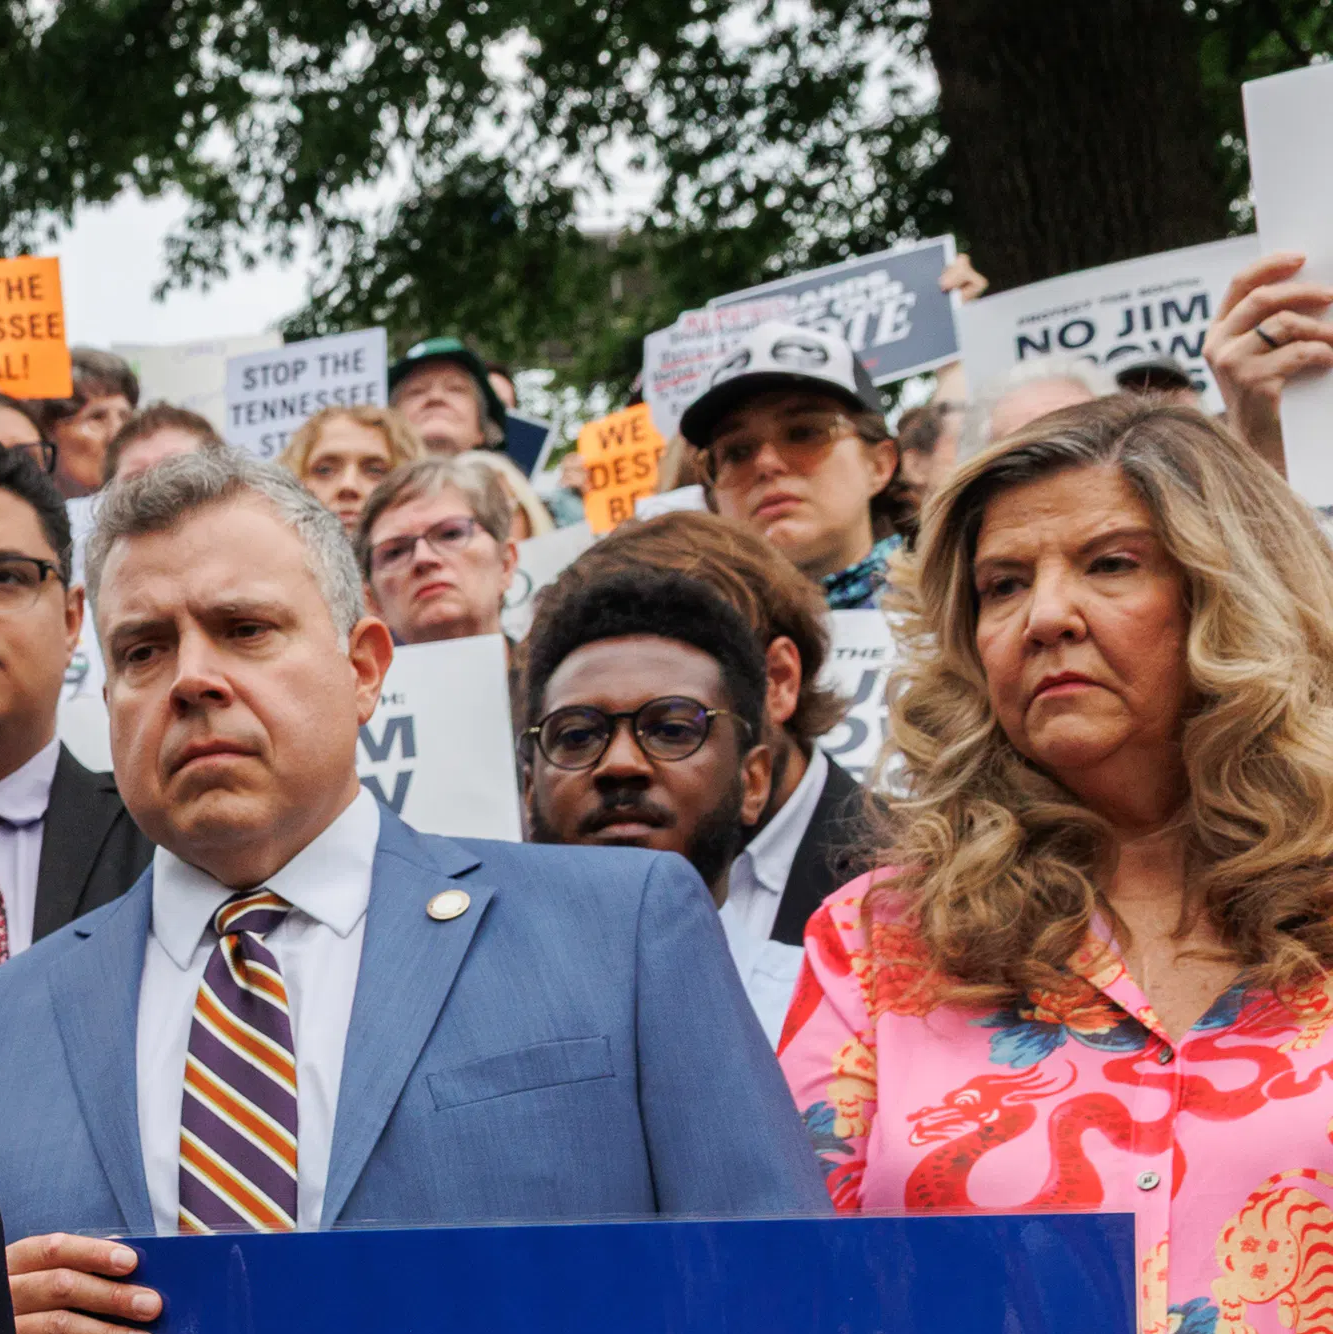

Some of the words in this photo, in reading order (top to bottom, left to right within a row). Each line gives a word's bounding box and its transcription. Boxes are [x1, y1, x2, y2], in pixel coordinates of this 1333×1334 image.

[1015, 318, 1097, 361] NO
[1117, 291, 1213, 338] JIM
[242, 358, 308, 392] STOP
[316, 347, 366, 377] THE
[598, 415, 647, 450] WE
